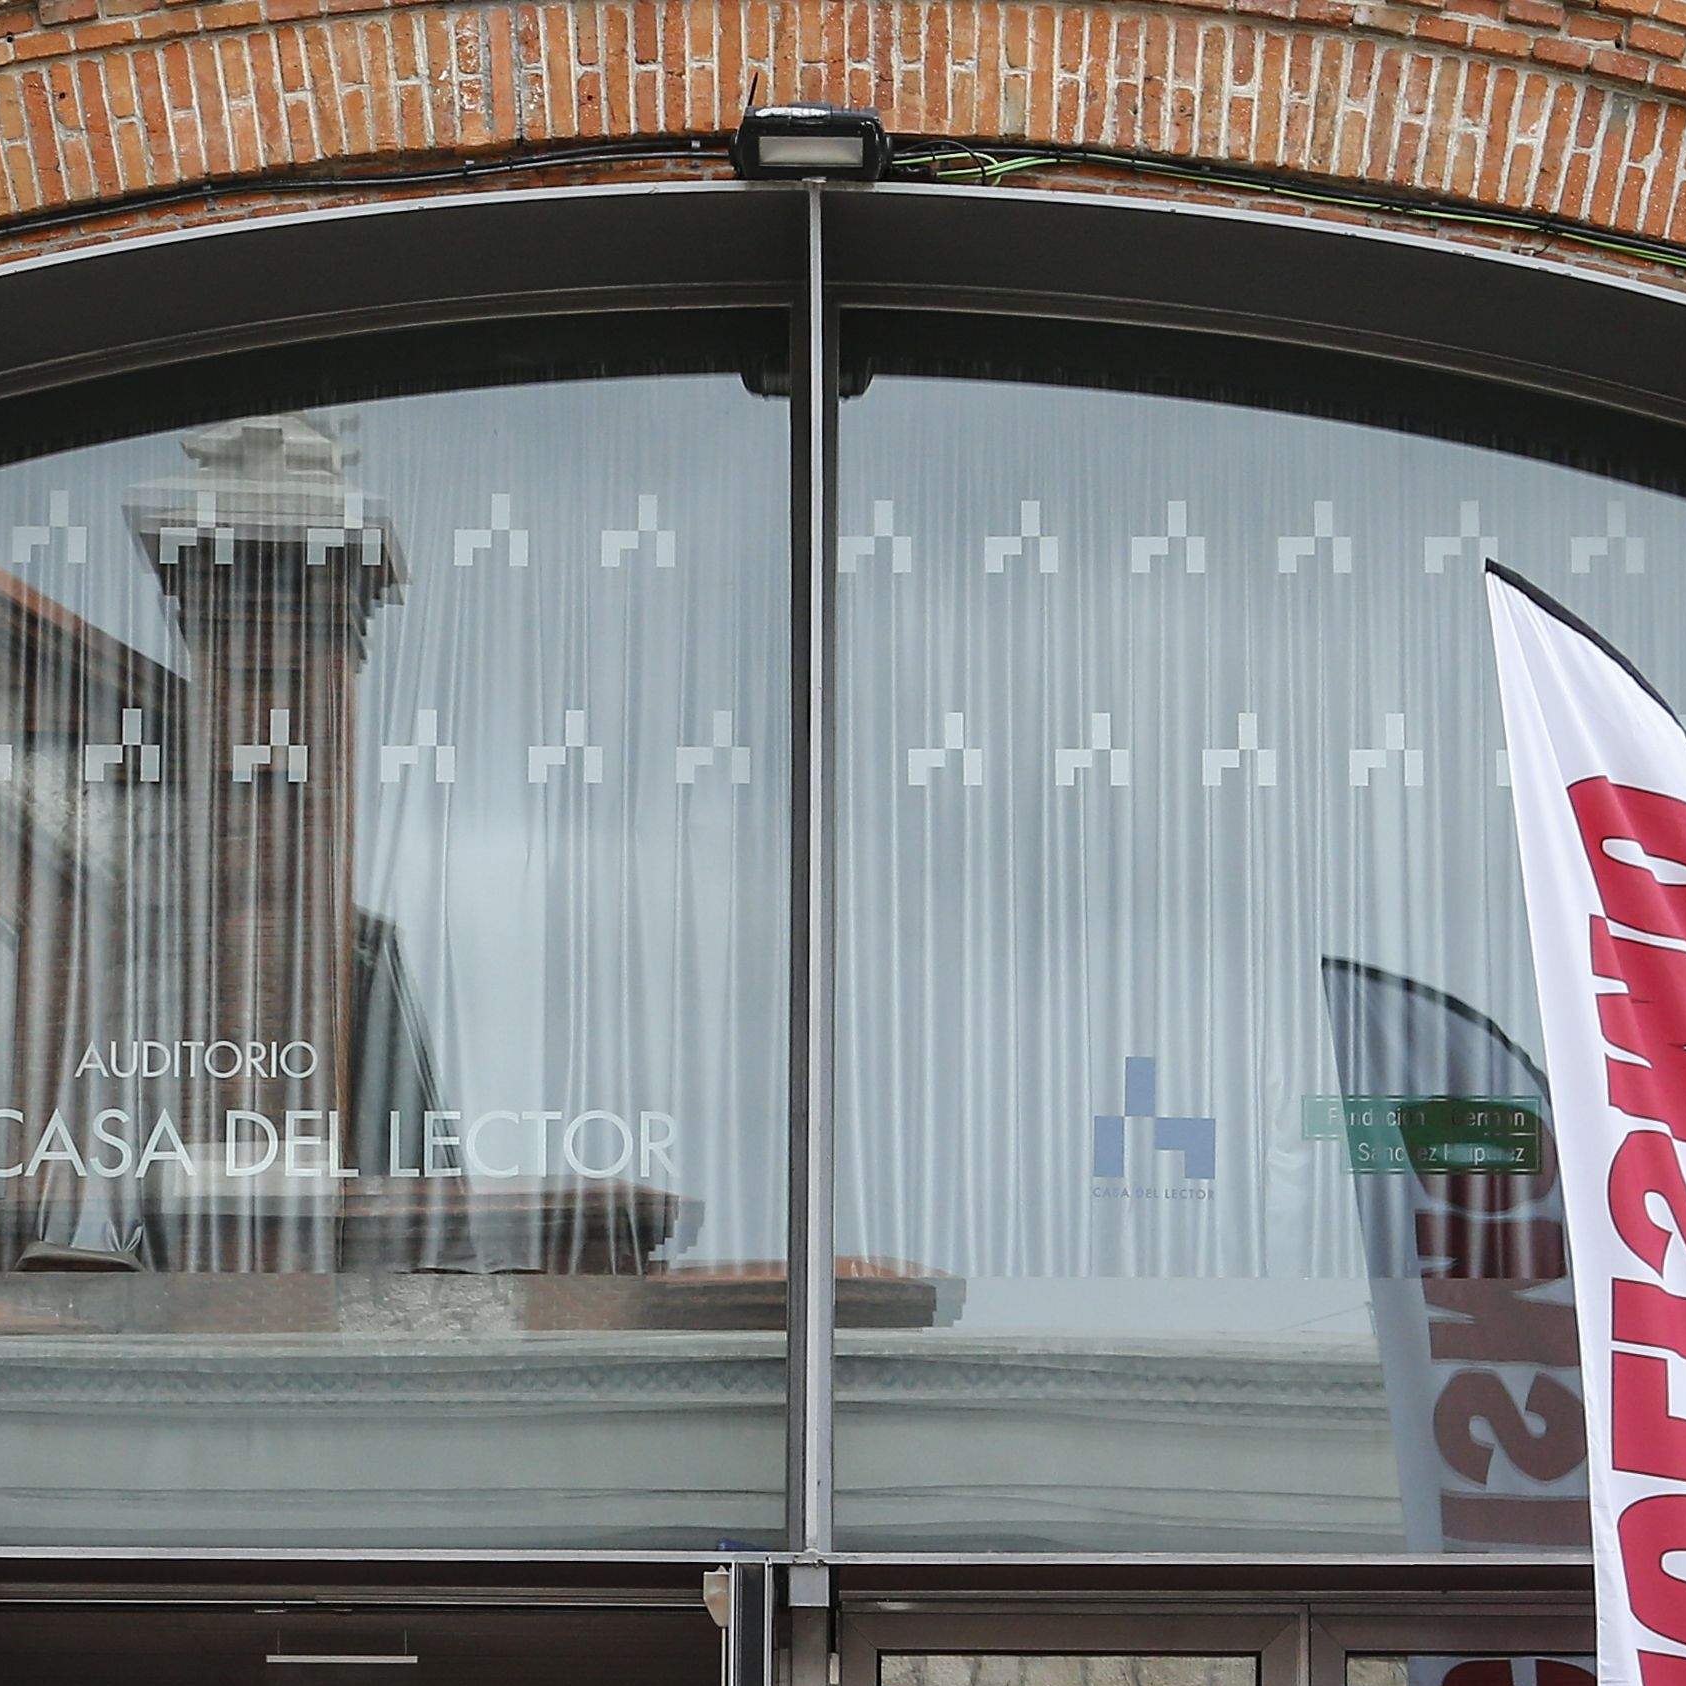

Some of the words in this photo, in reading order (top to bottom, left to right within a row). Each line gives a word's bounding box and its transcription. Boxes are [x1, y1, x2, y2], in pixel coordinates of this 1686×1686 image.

[74, 1040, 318, 1080] AUDITORIO
[226, 1109, 361, 1180] DEL
[389, 1108, 678, 1180] LECTOR
[1164, 1187, 1216, 1200] LECTOR
